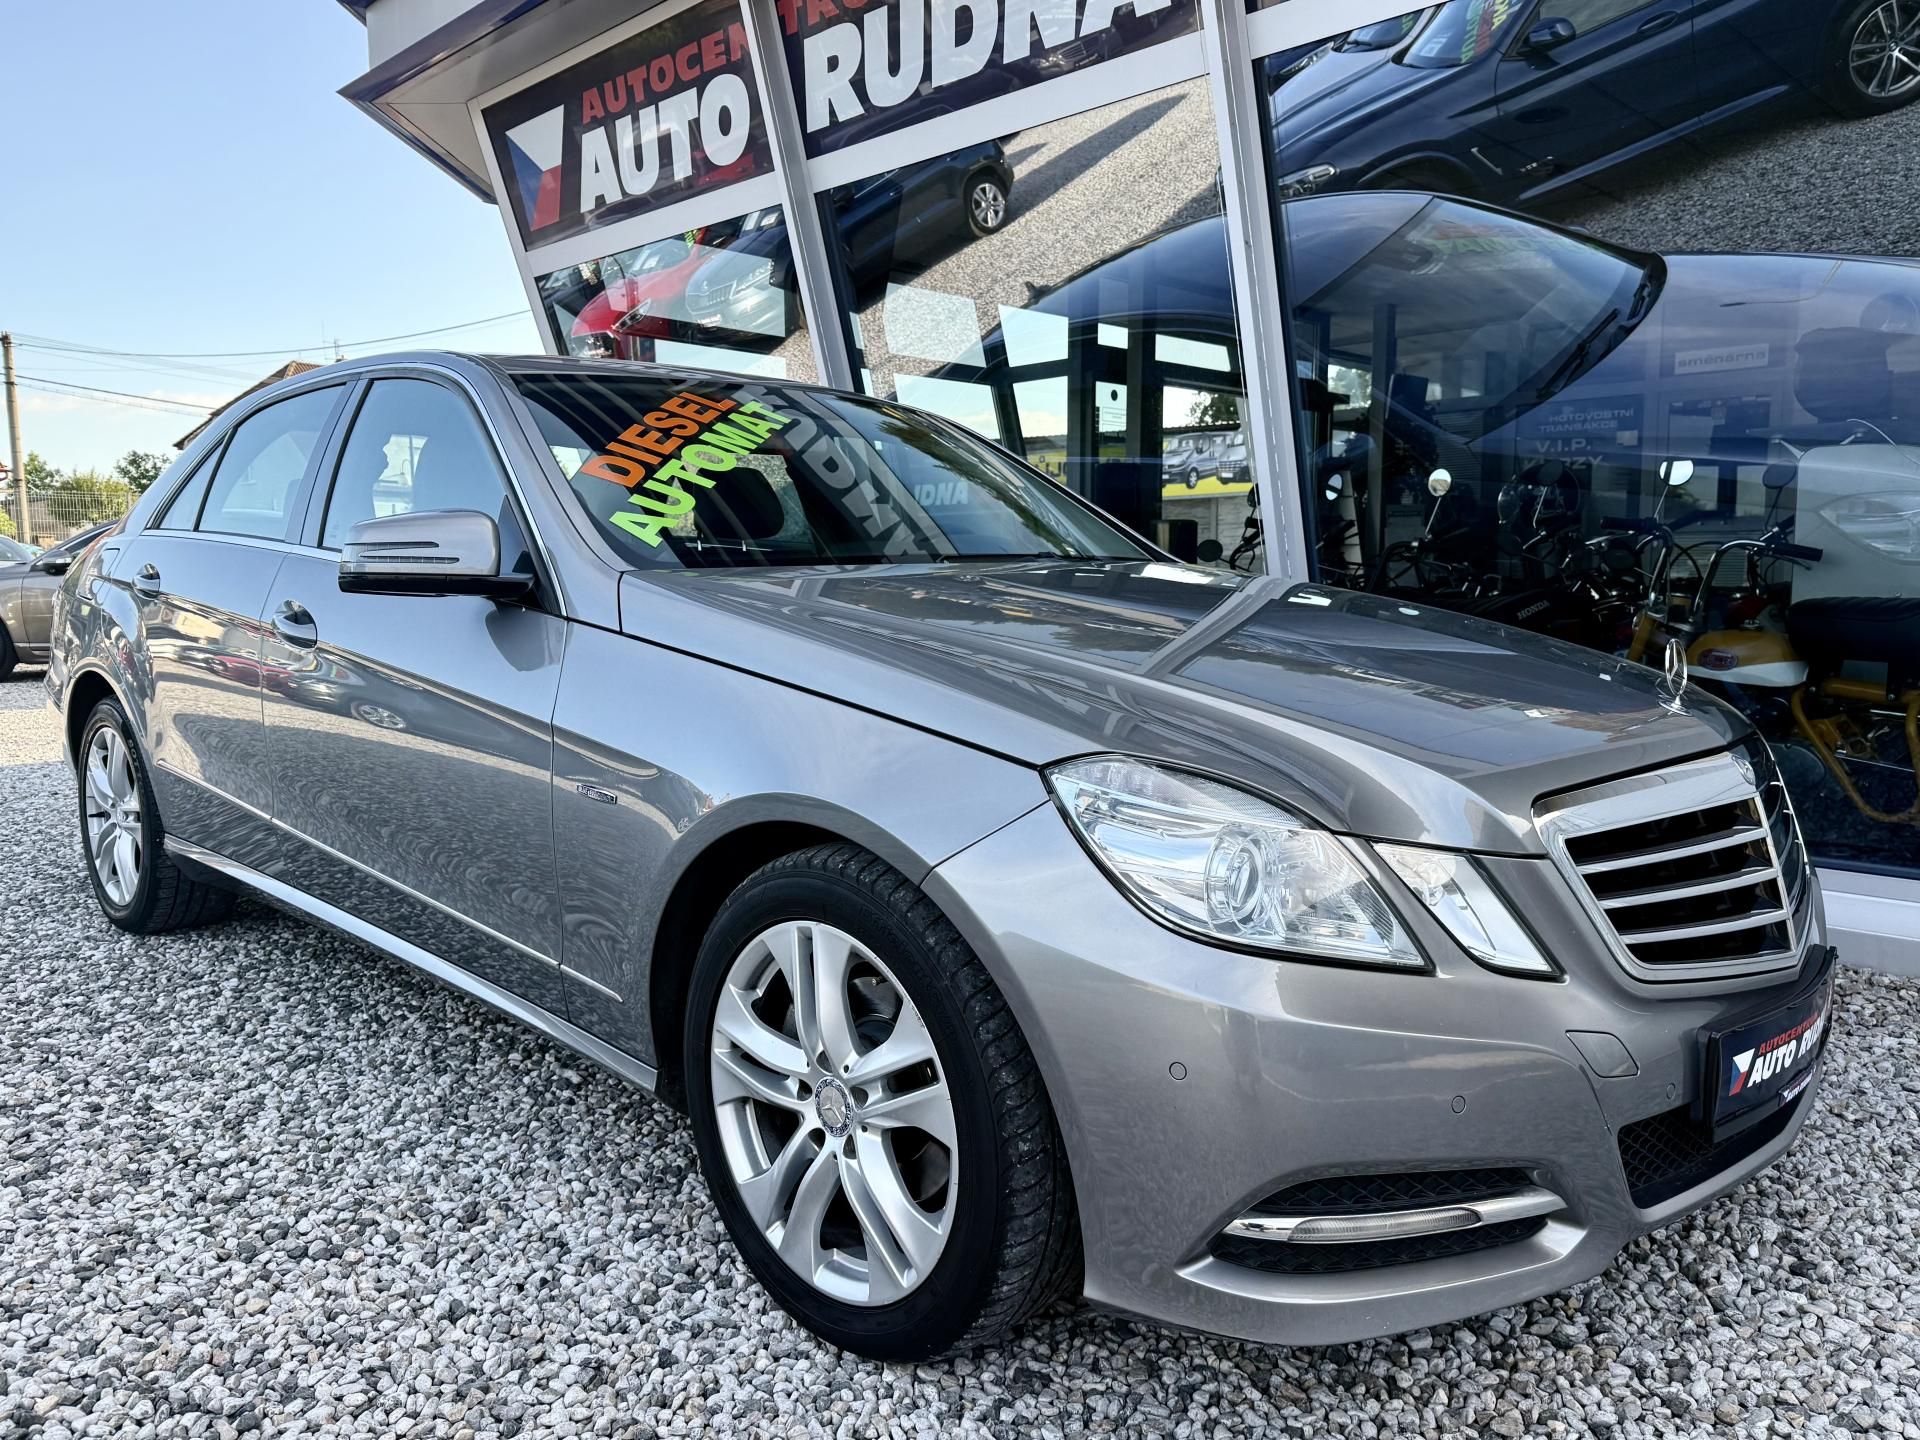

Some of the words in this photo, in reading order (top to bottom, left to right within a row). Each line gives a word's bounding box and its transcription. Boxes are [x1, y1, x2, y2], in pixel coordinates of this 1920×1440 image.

[580, 73, 751, 213] AUTO
[802, 0, 1172, 133] RUDN
[579, 391, 740, 489] DIESEL
[1536, 419, 1619, 433] TRANSAKCE
[1535, 438, 1592, 452] V.I.P.
[608, 399, 794, 549] AUTOMAT
[1520, 455, 1604, 472] KZY
[1516, 600, 1551, 621] HONDA
[1747, 1039, 1797, 1088] AUTO
